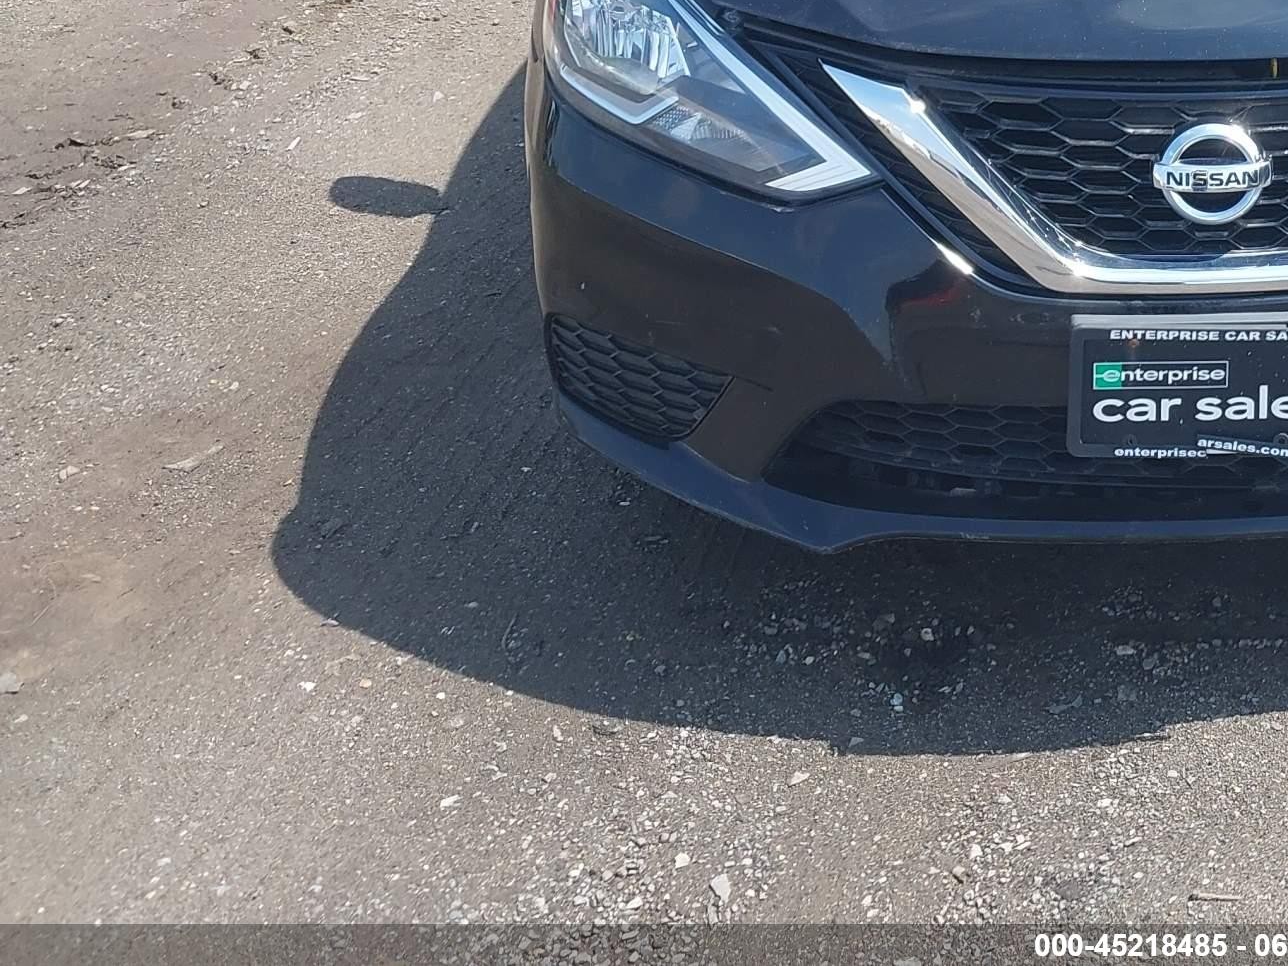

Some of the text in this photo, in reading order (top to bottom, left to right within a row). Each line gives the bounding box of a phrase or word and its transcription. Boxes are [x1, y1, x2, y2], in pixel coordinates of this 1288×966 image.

[1166, 169, 1258, 187] NISSAN
[1110, 330, 1220, 341] ENTERPRISE
[1225, 330, 1262, 341] CAR
[1102, 366, 1226, 384] enterprise
[1092, 397, 1182, 422] car
